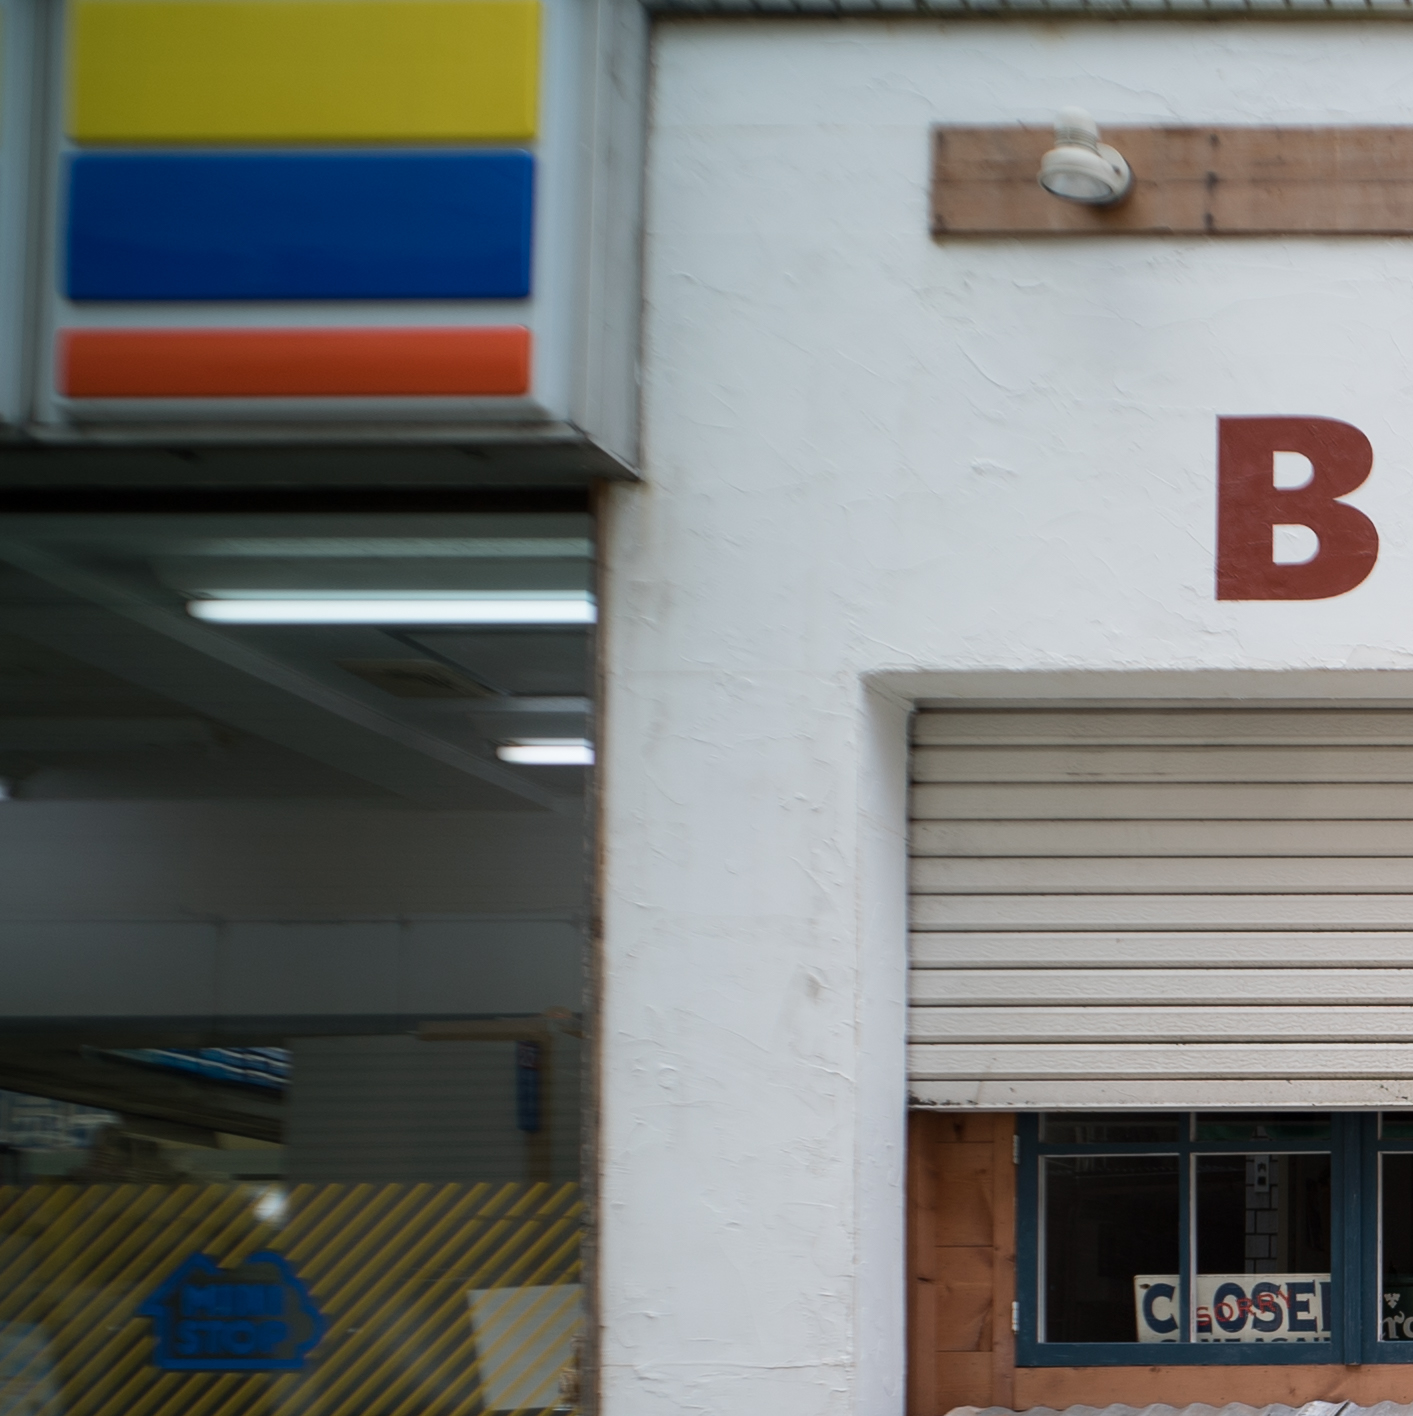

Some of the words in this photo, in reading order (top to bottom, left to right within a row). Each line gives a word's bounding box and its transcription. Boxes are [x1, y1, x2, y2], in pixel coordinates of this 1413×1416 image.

[181, 1284, 283, 1316] MINI
[1142, 1280, 1331, 1335] COSE
[1196, 1289, 1292, 1327] SORRY
[177, 1320, 288, 1355] STOP
